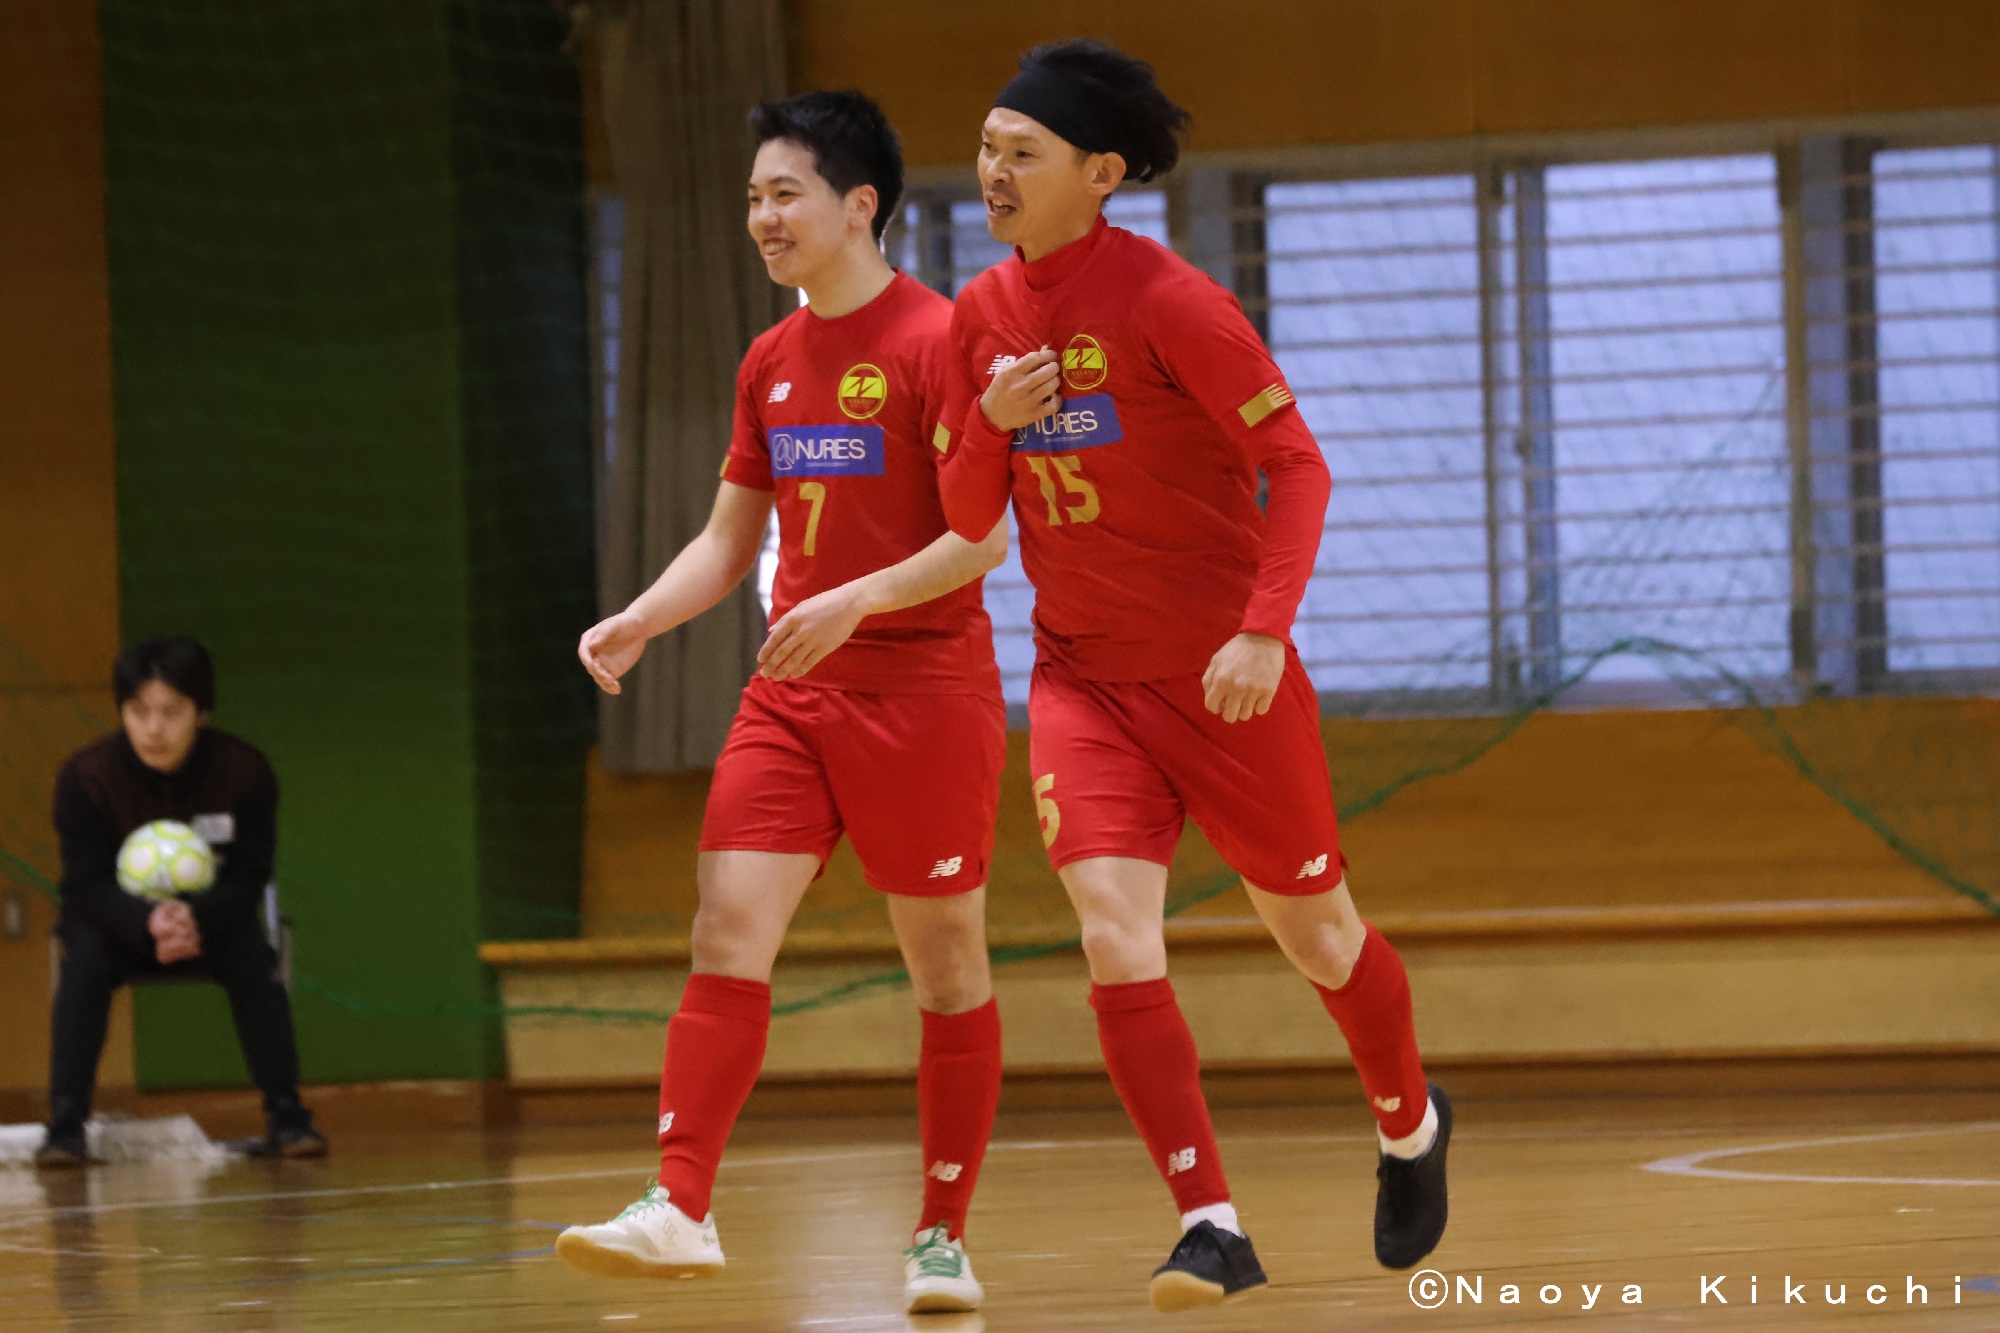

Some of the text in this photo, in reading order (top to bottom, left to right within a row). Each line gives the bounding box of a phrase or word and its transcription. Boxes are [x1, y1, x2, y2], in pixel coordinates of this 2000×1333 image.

[795, 438, 866, 460] NURES
[799, 482, 826, 557] 7
[1026, 455, 1100, 526] 15
